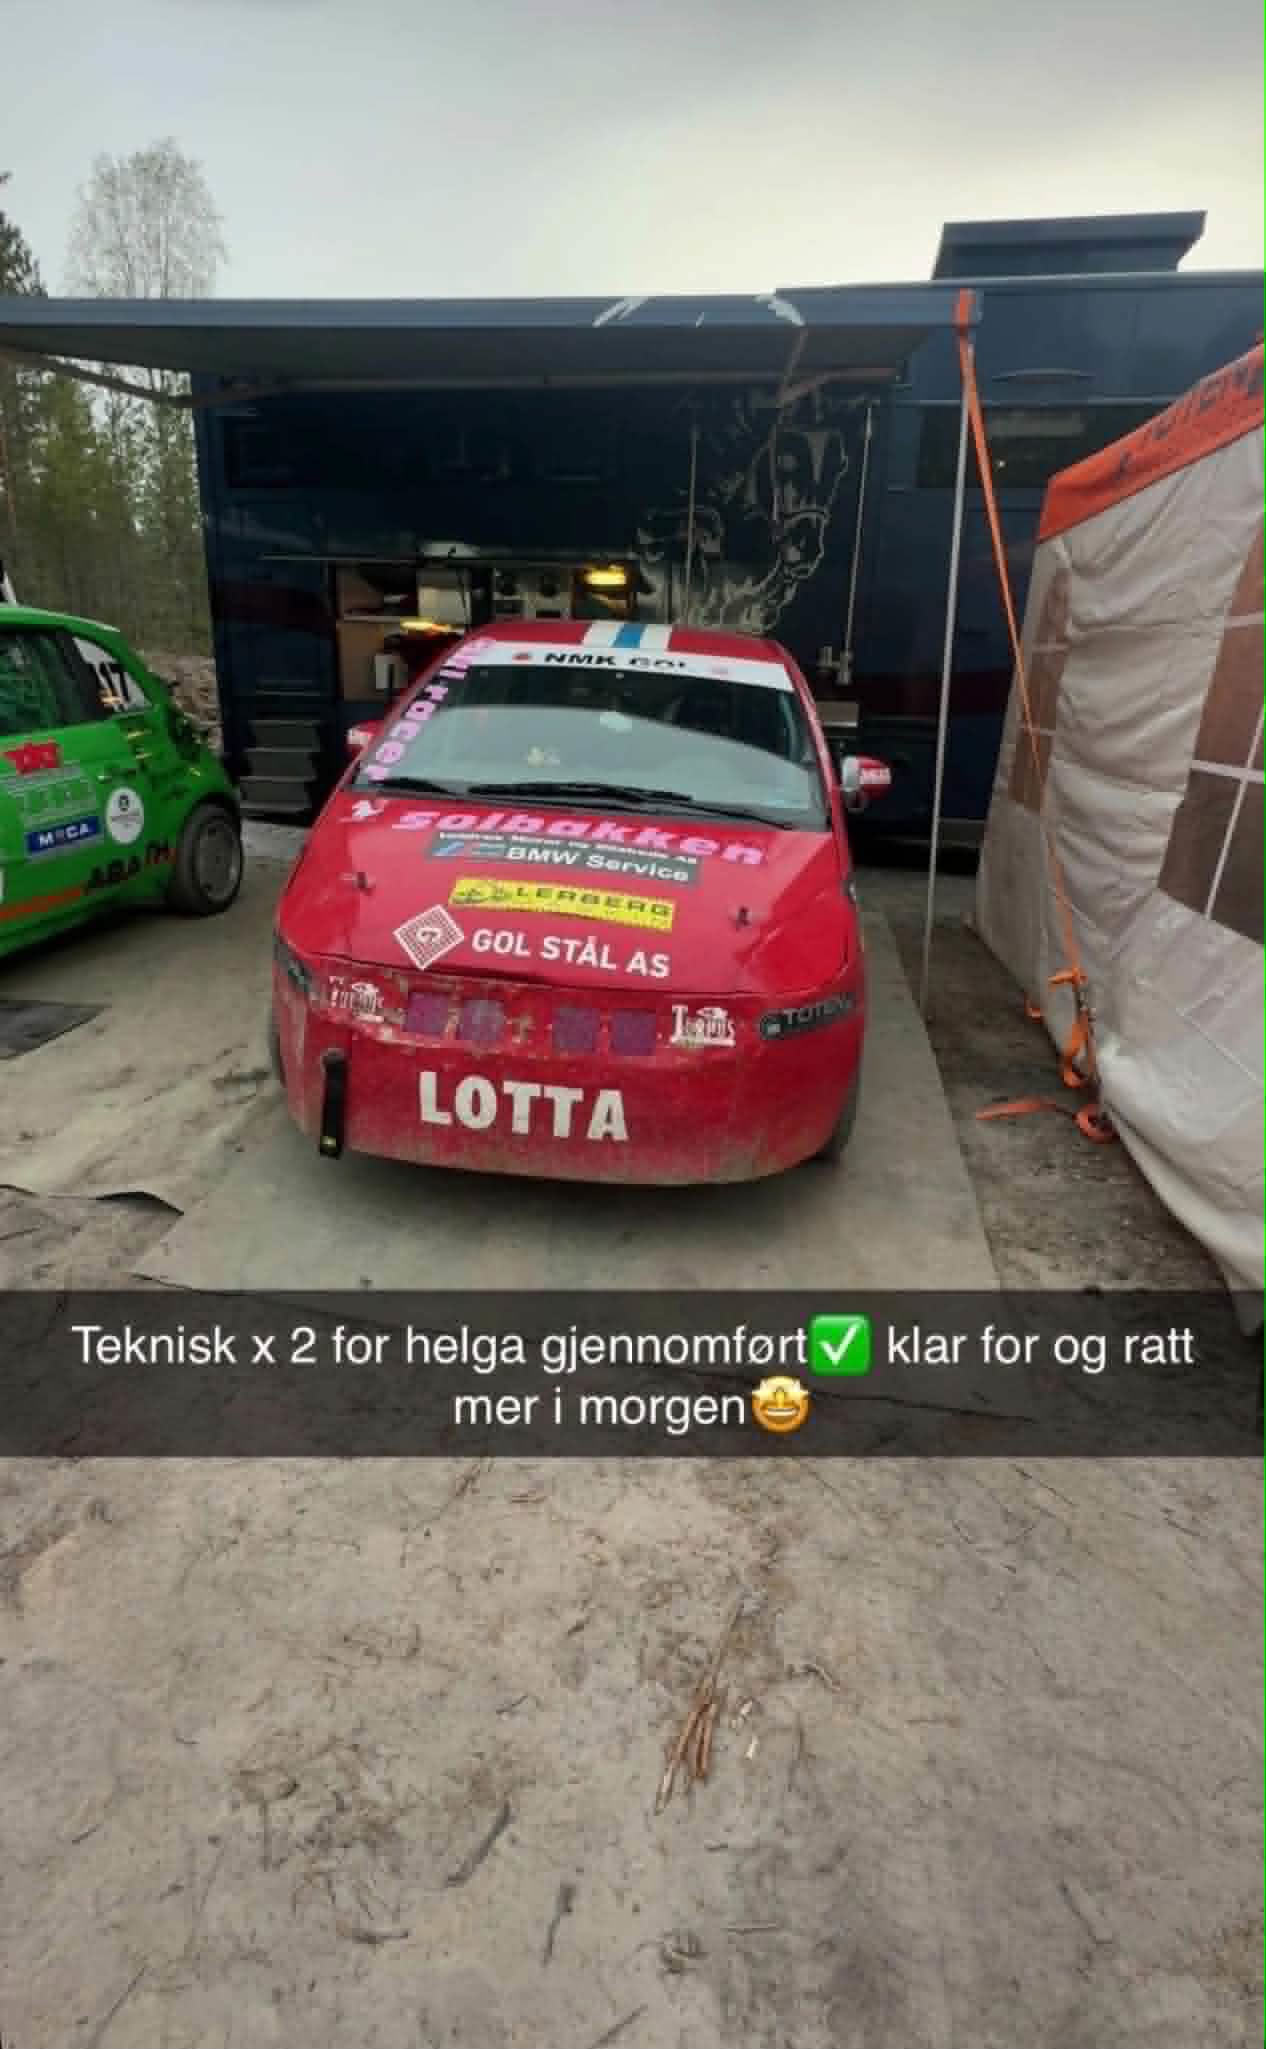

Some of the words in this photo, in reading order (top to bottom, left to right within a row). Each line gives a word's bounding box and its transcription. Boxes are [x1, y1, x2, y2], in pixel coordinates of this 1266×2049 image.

[544, 652, 617, 666] NMK
[506, 846, 582, 865] BMW
[586, 854, 690, 882] Service
[471, 927, 532, 957] GOL
[540, 934, 617, 970] STÅL
[625, 950, 671, 978] AS
[418, 1070, 630, 1142] LOTTA
